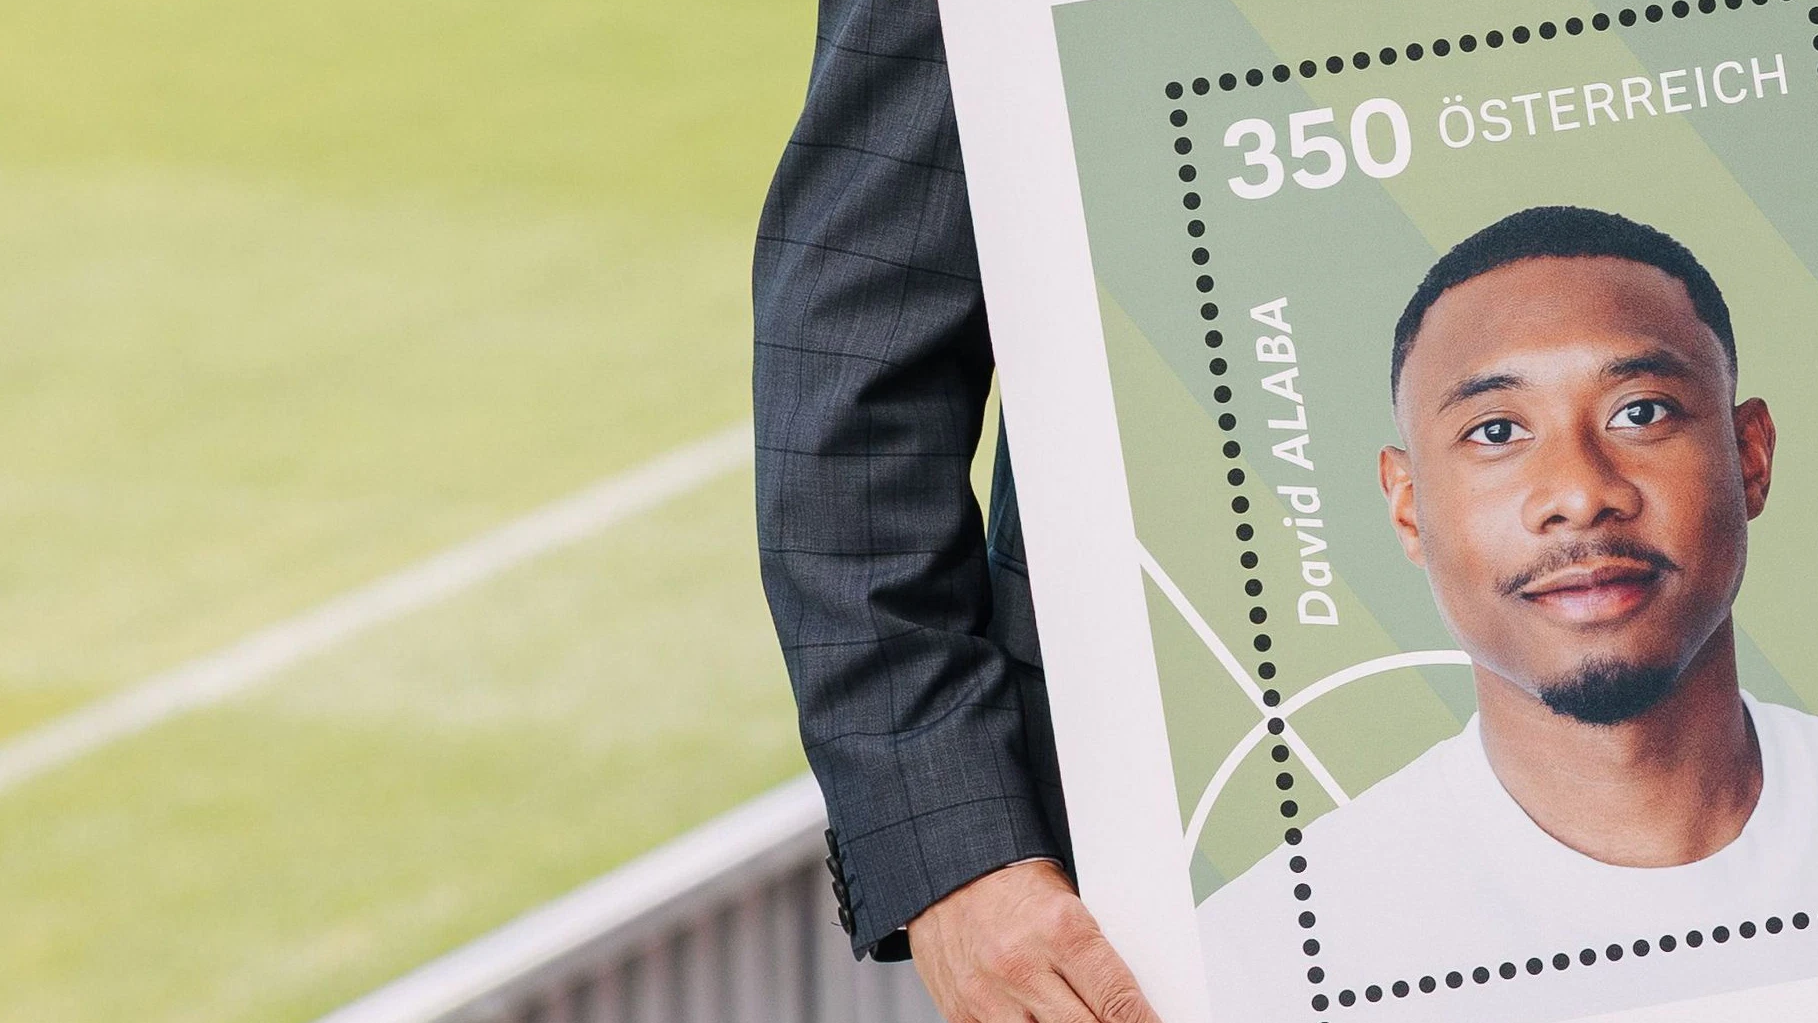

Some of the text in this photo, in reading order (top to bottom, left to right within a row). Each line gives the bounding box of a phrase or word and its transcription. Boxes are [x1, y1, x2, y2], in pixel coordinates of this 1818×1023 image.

[1223, 53, 1789, 200] 350 ÖSTERREICH
[1249, 296, 1340, 626] David ALABA
